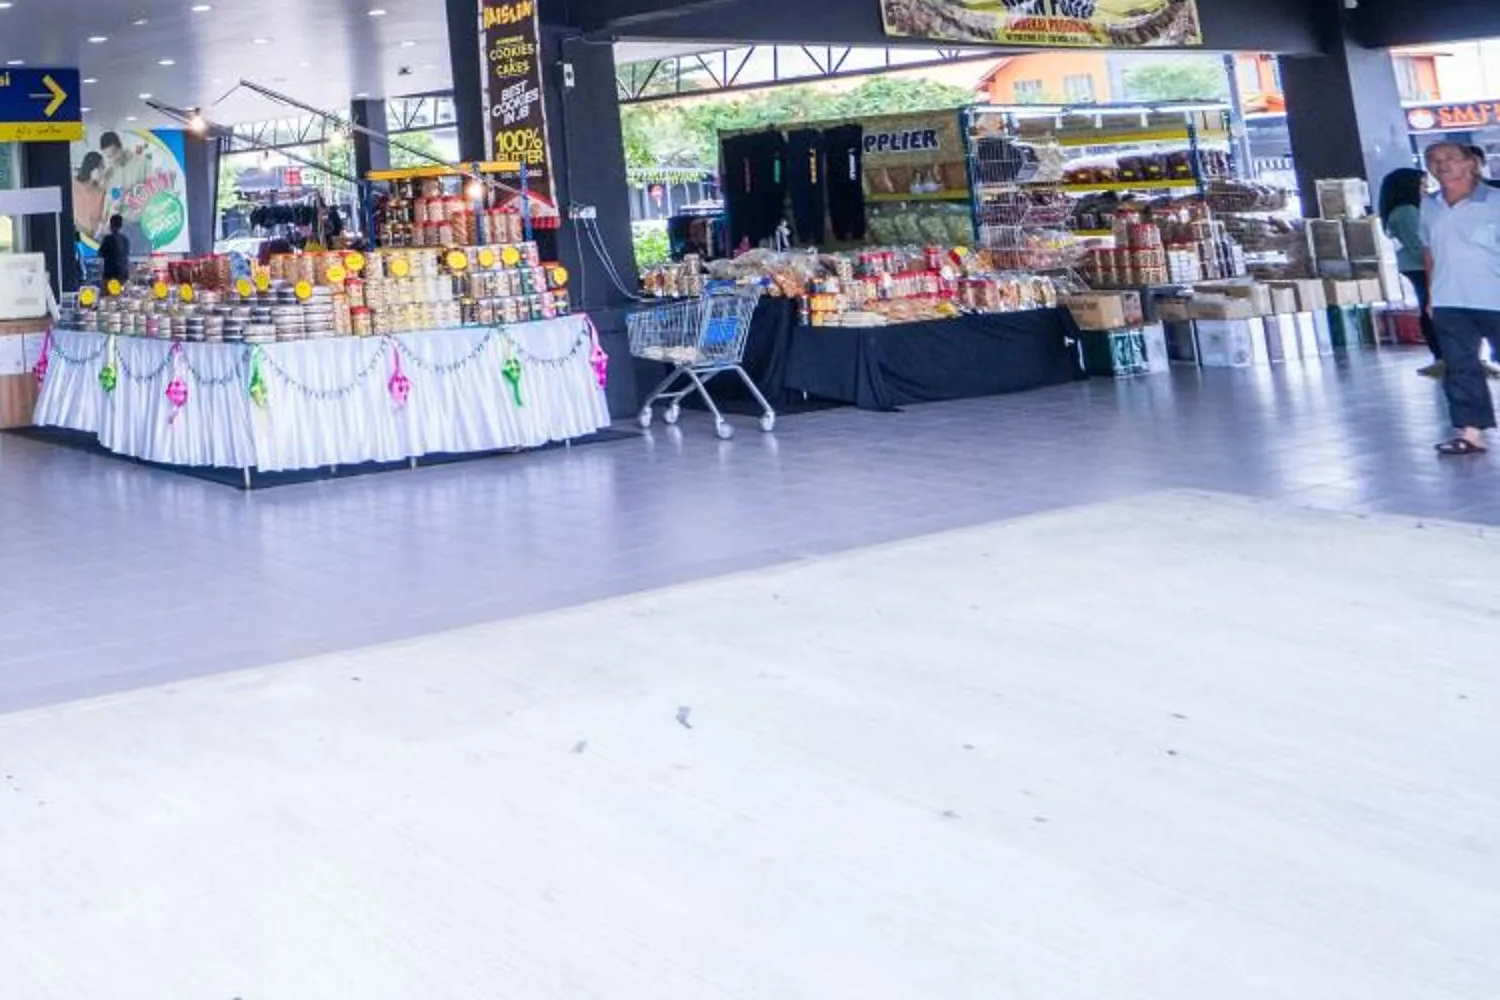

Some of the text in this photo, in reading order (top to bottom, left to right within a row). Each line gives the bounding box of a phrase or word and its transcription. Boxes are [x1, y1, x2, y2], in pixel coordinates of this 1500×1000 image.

[490, 43, 534, 61] COOKIES
[502, 80, 528, 102] BEST
[492, 88, 538, 117] COOKIES
[504, 111, 515, 125] IN
[496, 128, 543, 152] 100%
